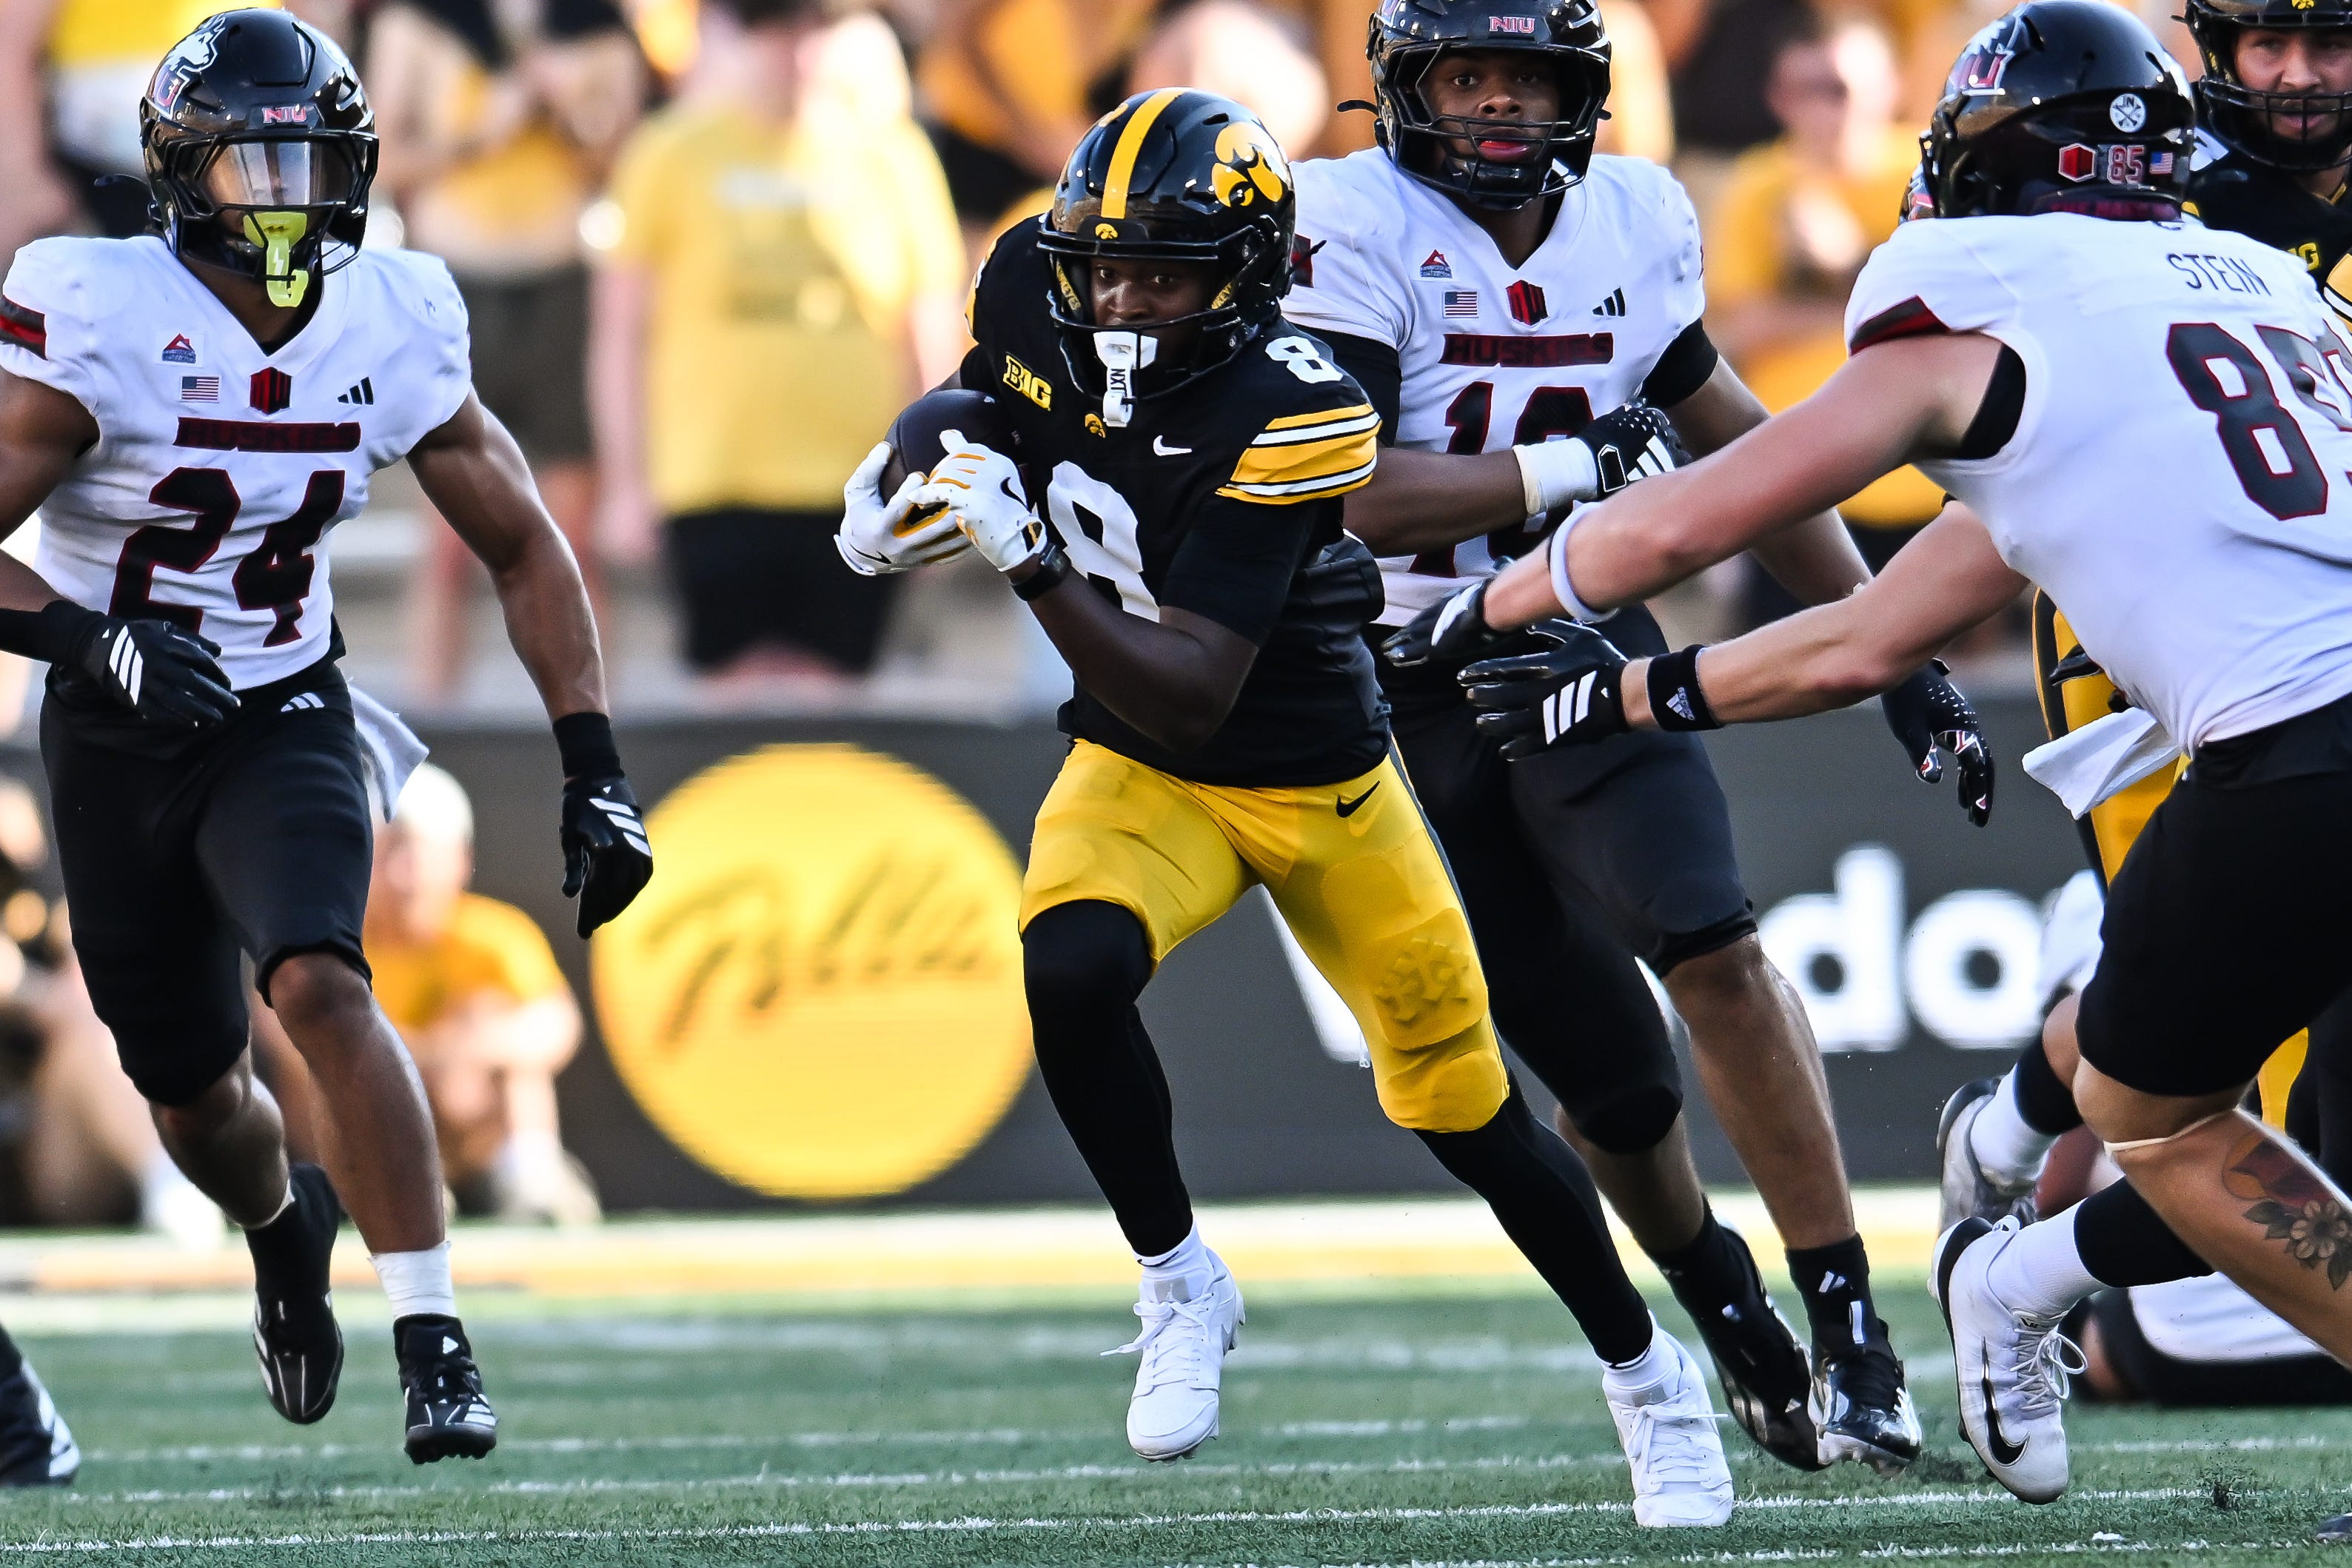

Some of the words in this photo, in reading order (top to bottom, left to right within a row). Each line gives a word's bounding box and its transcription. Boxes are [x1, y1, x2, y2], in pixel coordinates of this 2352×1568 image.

[1489, 16, 1535, 33] NIU
[261, 106, 307, 124] NIU
[2107, 144, 2145, 184] 85
[2166, 253, 2271, 297] STEIN
[1265, 336, 1344, 384] 8
[1438, 332, 1614, 367] HUSKIES
[108, 466, 346, 648] 24
[1047, 460, 1160, 623] 8
